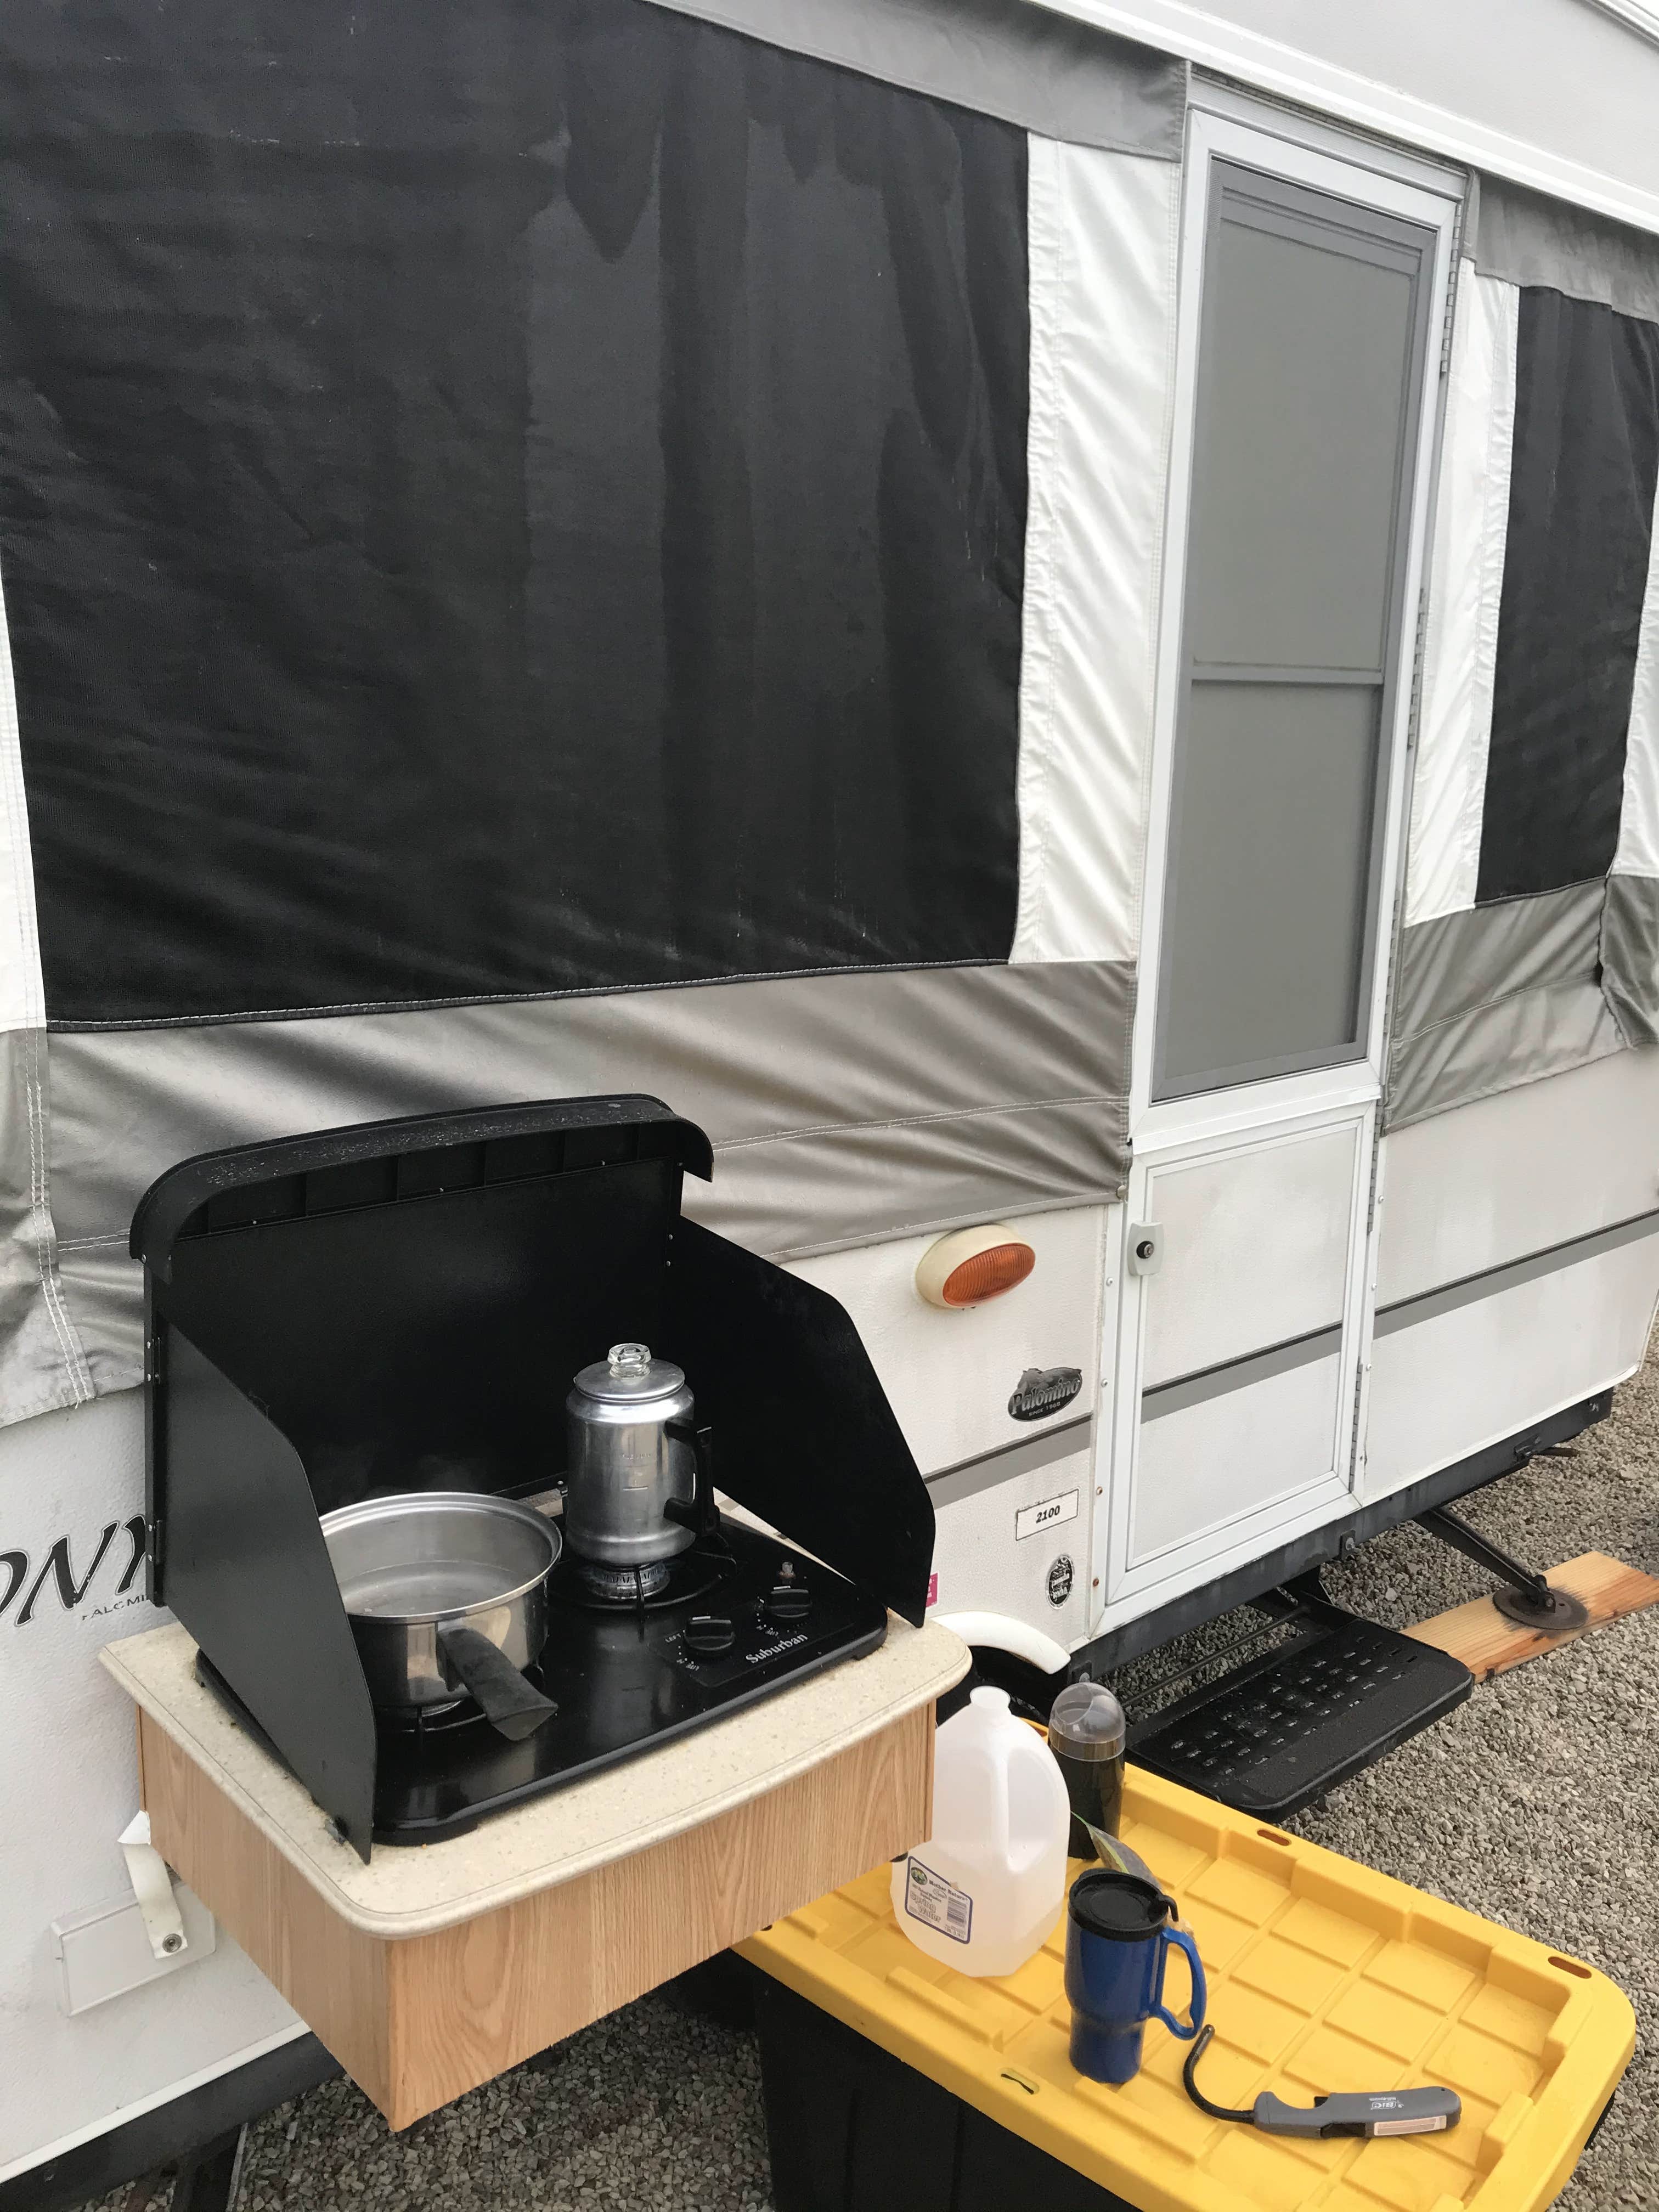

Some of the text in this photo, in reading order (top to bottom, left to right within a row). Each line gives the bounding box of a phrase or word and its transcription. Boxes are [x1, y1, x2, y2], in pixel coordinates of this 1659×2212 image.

[1011, 1378, 1080, 1415] Palomino
[1035, 1505, 1060, 1523] 2100
[746, 1633, 808, 1664] Suburban
[929, 1879, 946, 1891] Mother
[910, 1891, 936, 1914] Spring
[917, 1904, 941, 1923] Water
